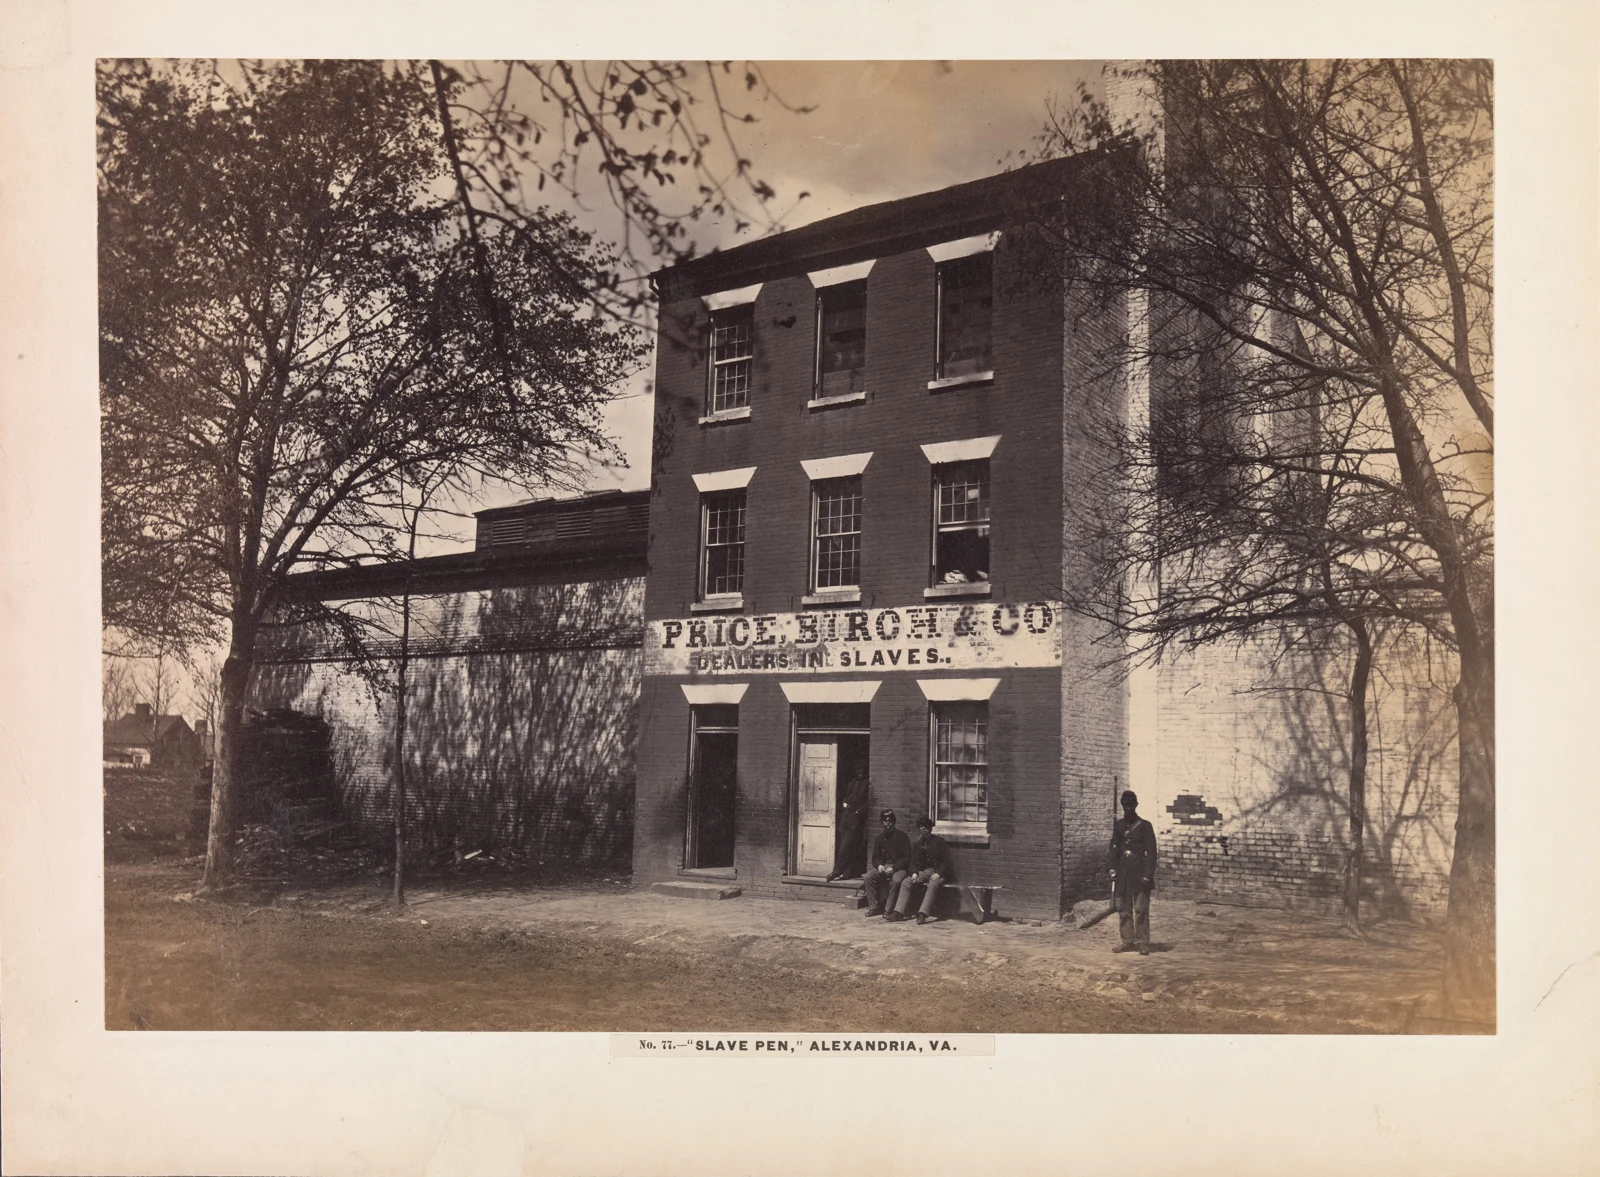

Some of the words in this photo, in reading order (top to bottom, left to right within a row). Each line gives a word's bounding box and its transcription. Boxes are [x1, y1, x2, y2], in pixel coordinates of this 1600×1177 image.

[795, 607, 942, 644] BIRCH
[953, 605, 977, 637] &
[991, 602, 1053, 636] CO
[698, 653, 789, 671] DEALERS
